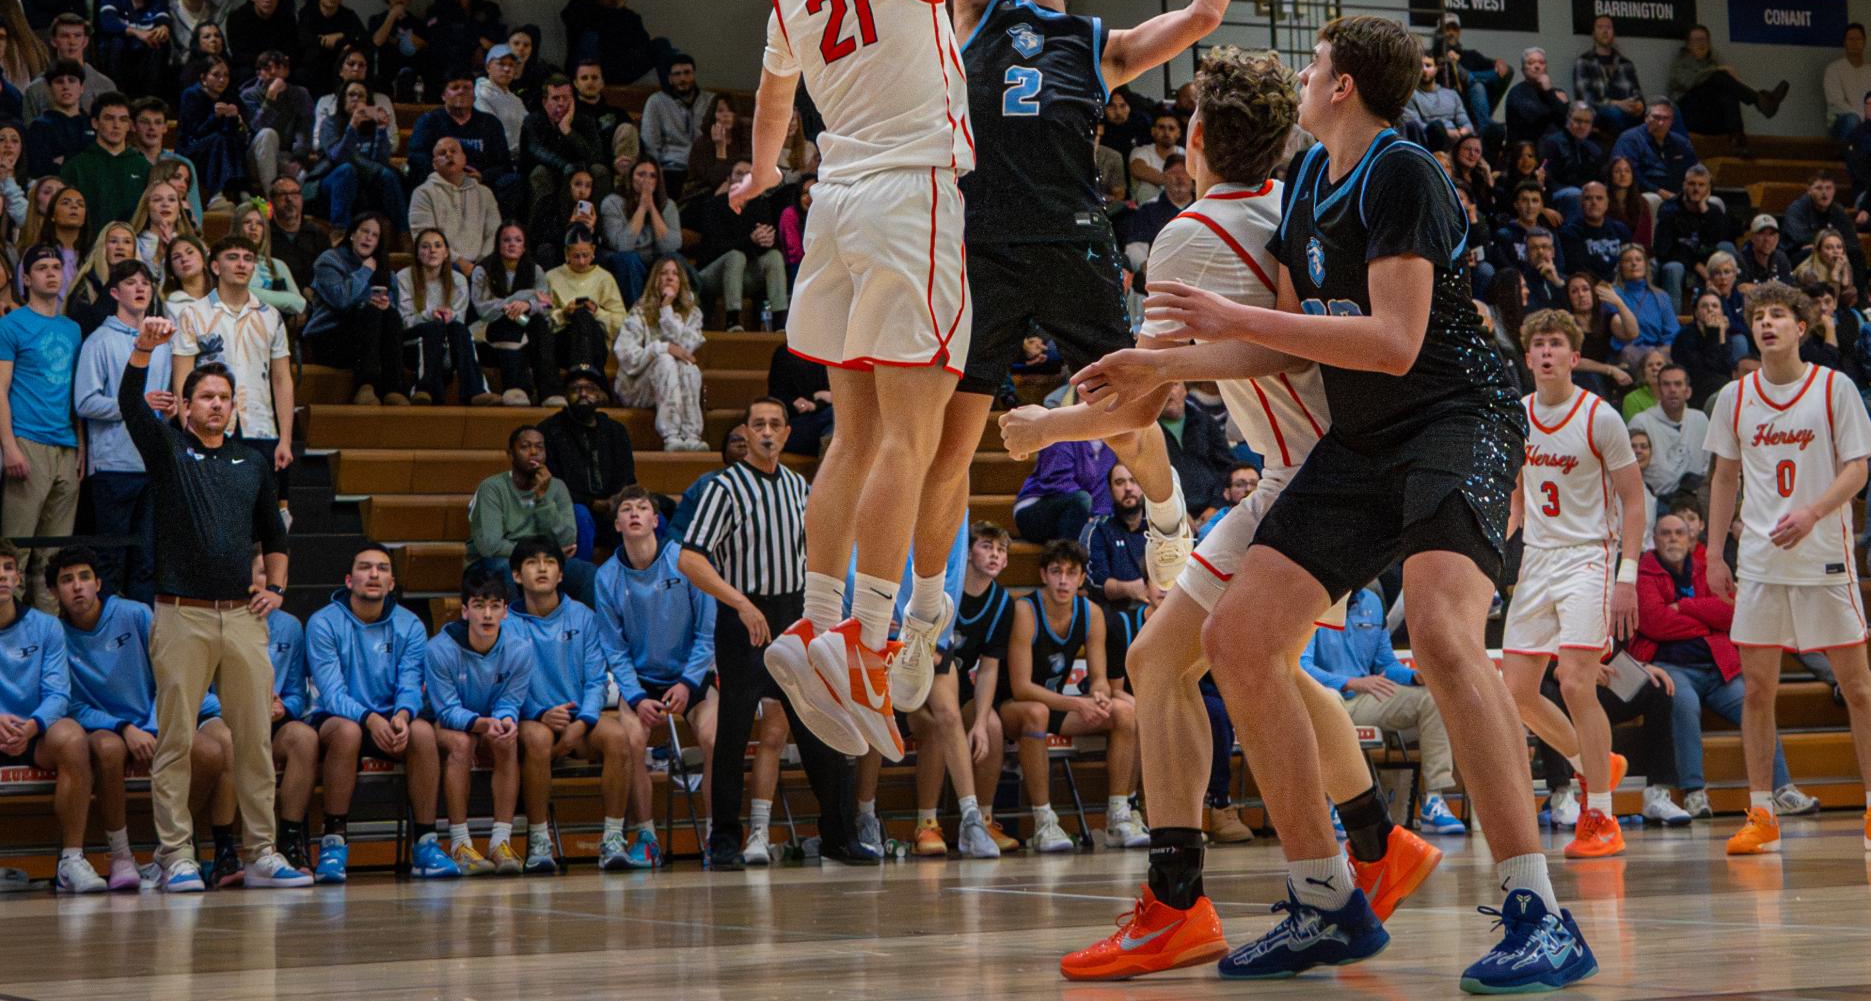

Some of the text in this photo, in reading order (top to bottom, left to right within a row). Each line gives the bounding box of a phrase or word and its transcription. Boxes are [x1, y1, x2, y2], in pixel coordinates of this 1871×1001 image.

[1763, 7, 1812, 28] CONANT
[1002, 64, 1044, 117] 2
[1751, 422, 1815, 451] Hersey
[1523, 444, 1579, 475] Hersey
[1776, 459, 1796, 498] 0
[1540, 480, 1561, 518] 3
[20, 644, 39, 658] P
[115, 631, 132, 649] P
